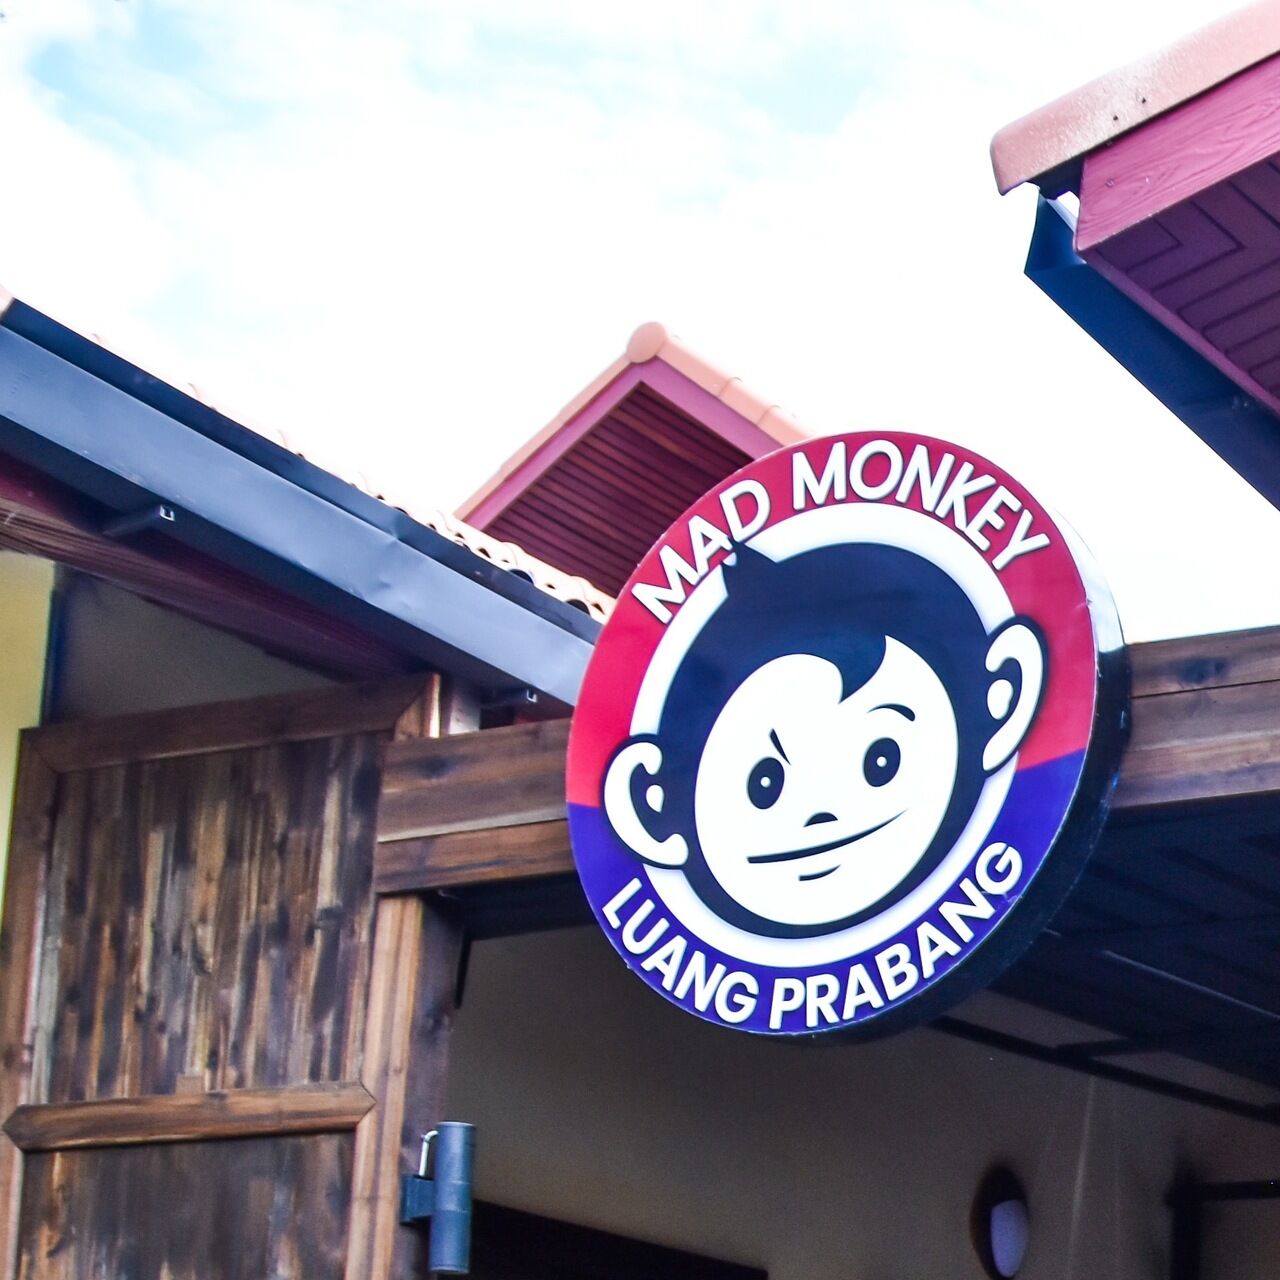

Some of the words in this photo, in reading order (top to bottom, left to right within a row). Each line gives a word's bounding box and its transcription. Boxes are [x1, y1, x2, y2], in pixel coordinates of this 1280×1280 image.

[631, 479, 772, 625] MAD
[791, 439, 1051, 572] MONKEY
[602, 877, 758, 1024] LUANG
[769, 841, 1023, 1030] PRABANG
